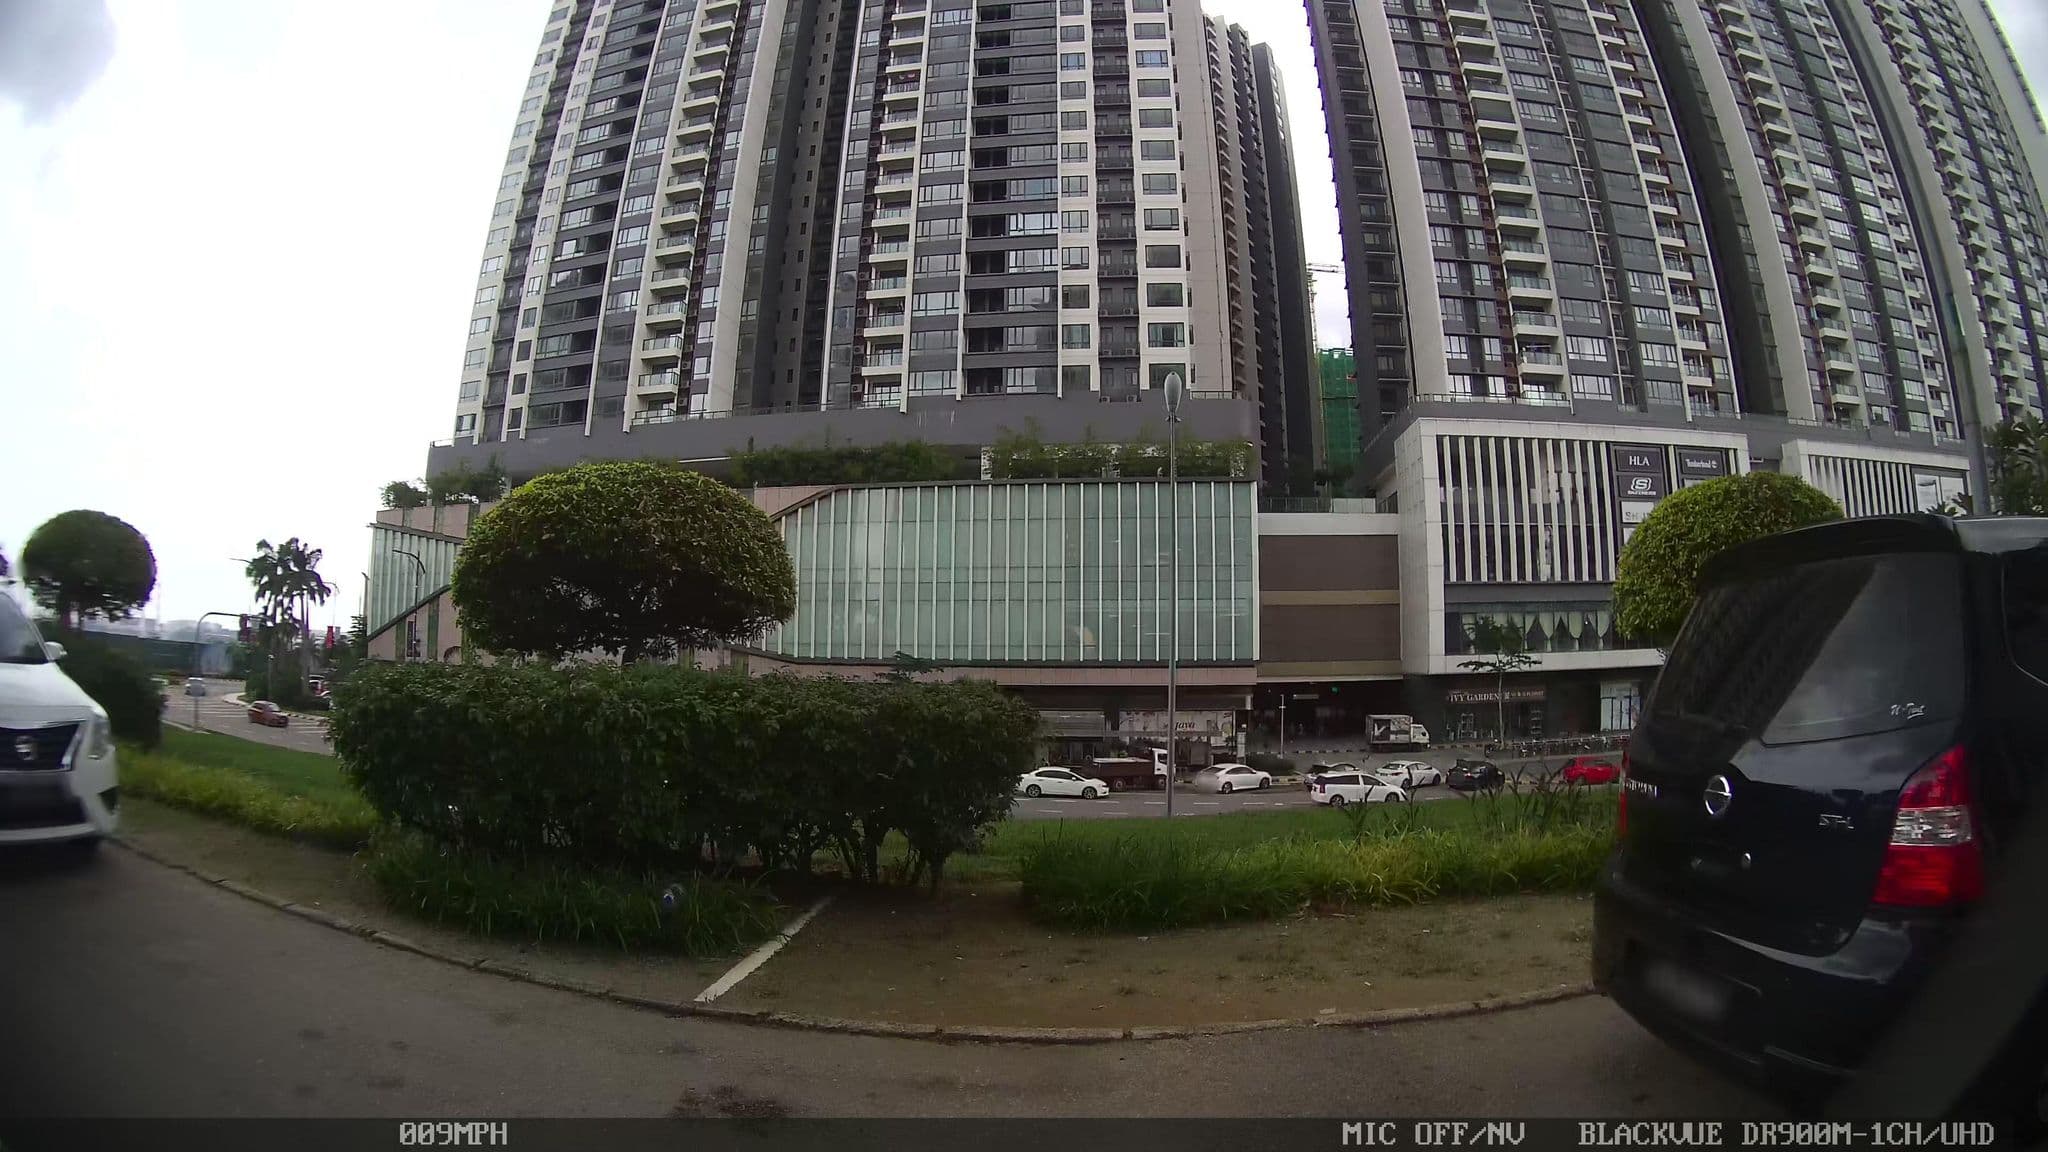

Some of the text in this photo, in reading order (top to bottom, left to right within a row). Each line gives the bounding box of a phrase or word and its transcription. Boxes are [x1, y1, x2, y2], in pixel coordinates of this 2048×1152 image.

[1629, 455, 1650, 466] HLA
[1450, 694, 1464, 702] IVY
[1466, 692, 1500, 701] GARDEN
